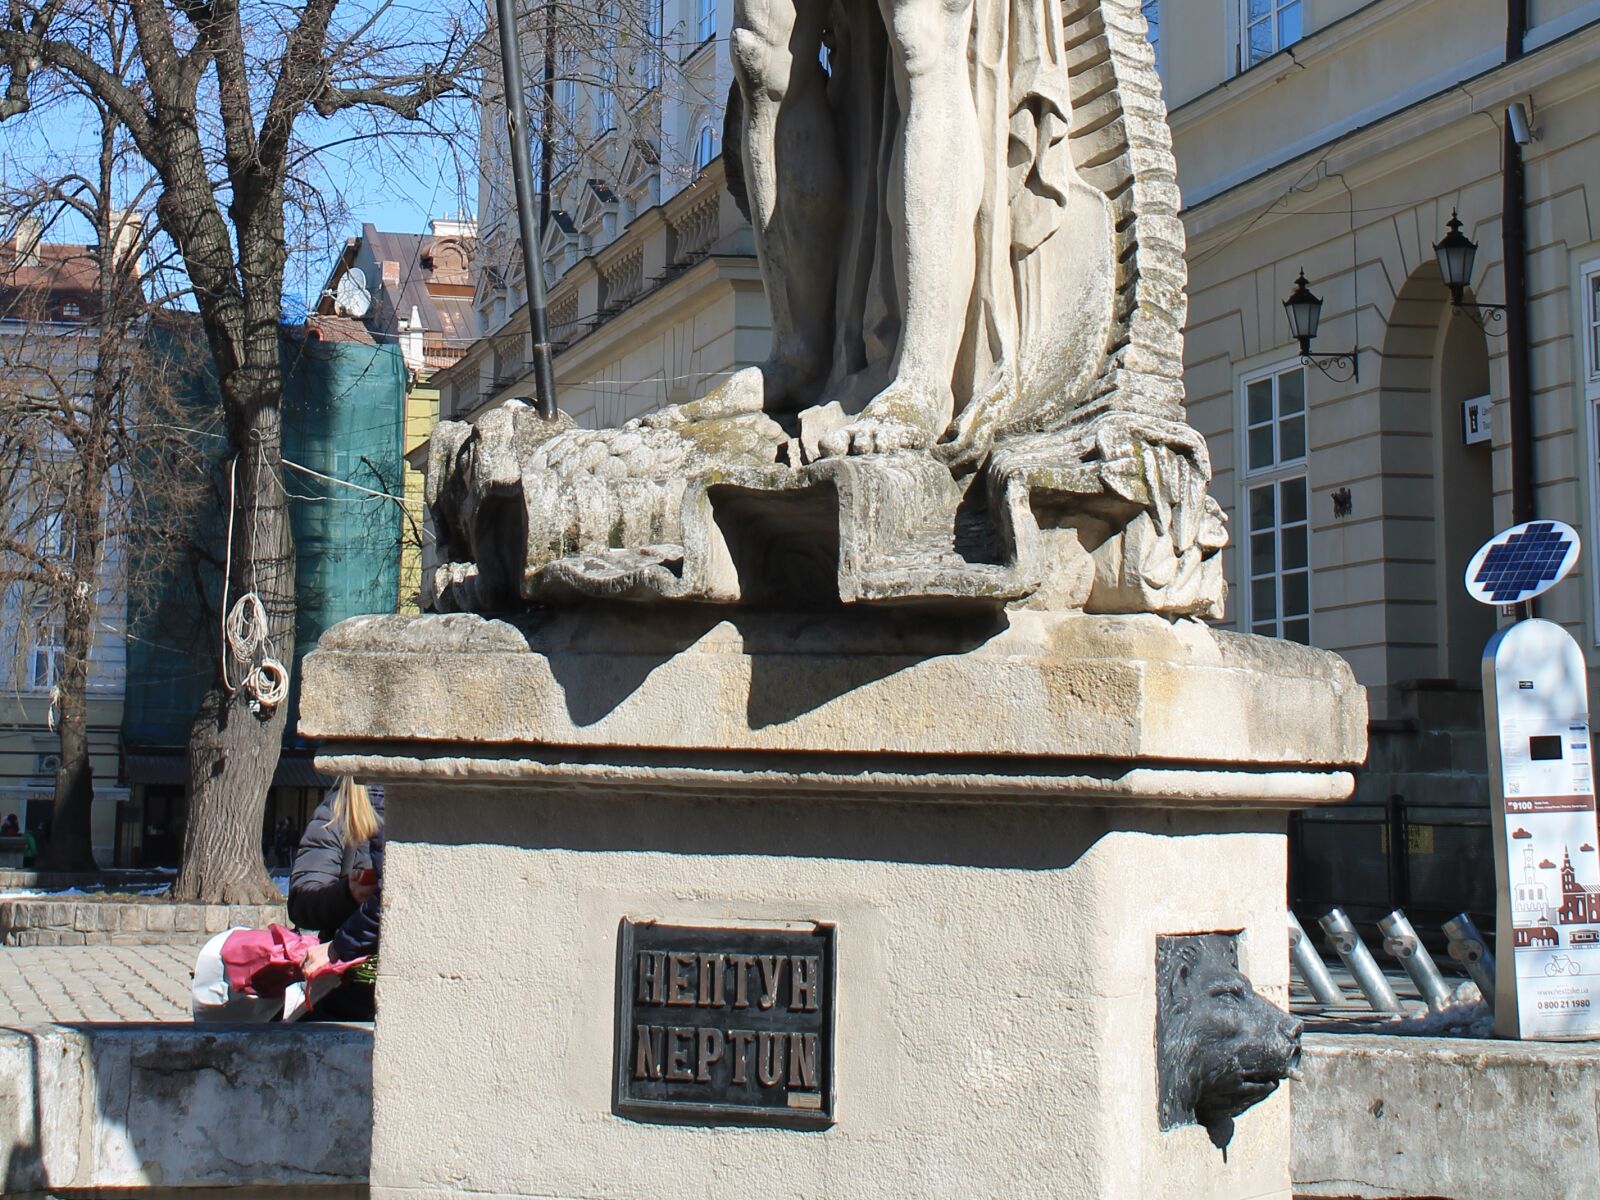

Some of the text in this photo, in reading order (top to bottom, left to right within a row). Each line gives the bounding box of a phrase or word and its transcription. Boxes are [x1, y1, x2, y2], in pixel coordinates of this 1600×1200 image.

[1512, 801, 1533, 810] 9100
[636, 950, 820, 1012] НЕПТУН
[1537, 999, 1591, 1009] 0 800 21 1980
[635, 1024, 818, 1088] NEPTUN
